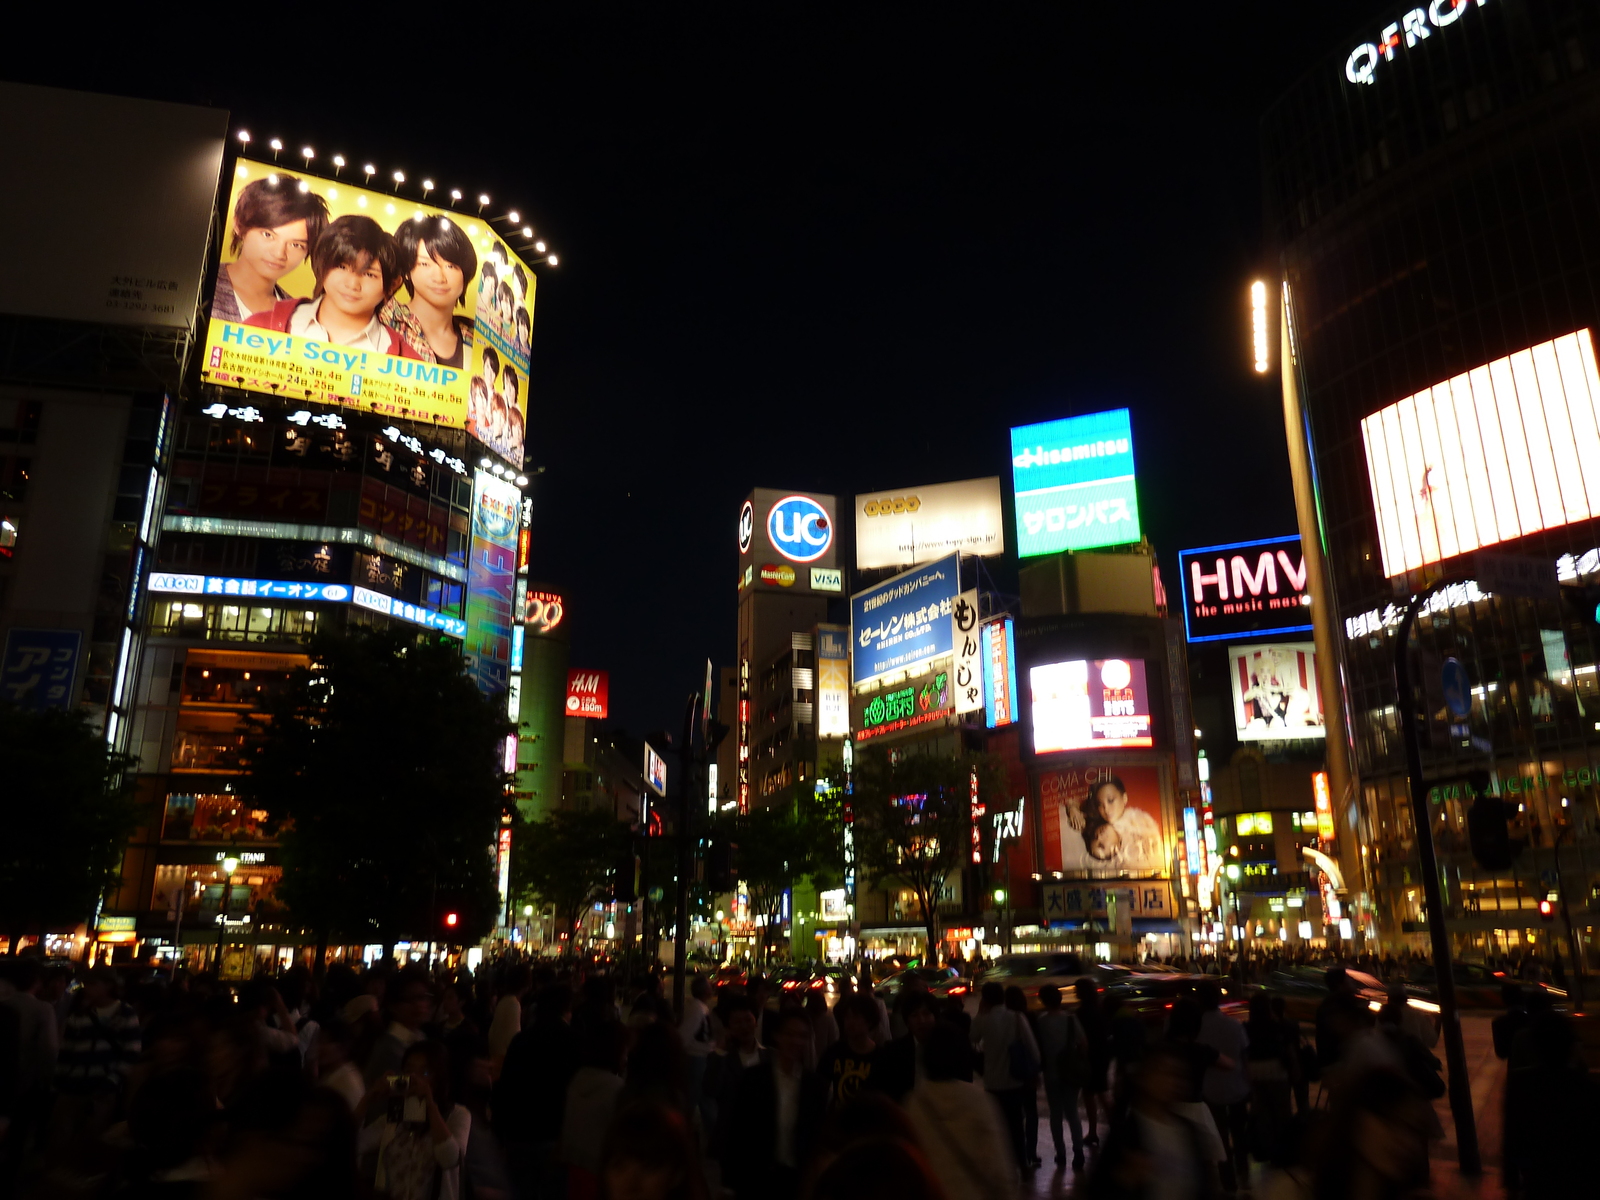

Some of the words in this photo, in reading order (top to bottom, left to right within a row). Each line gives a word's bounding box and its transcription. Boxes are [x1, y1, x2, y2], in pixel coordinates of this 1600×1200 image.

[1345, 0, 1486, 85] QFRO
[222, 324, 293, 355] Hey!
[303, 341, 367, 371] Say!
[377, 357, 458, 386] JUMP
[202, 484, 322, 512] プライス
[360, 497, 444, 545] コンタクト
[1023, 498, 1130, 534] サロンパス
[153, 574, 198, 589] AEON
[207, 577, 319, 597] 英会話イーオン
[760, 569, 796, 581] MasterCard
[814, 574, 840, 585] VISA
[1190, 549, 1307, 604] HMV
[356, 587, 387, 611] AEON
[527, 590, 562, 604] HIBUYA
[1195, 603, 1218, 618] the
[1223, 597, 1263, 615] music
[393, 599, 466, 636] 英会話イーオン
[525, 598, 563, 632] 09
[859, 596, 952, 647] セーレン株式会社
[953, 598, 979, 704] もんじゃ
[47, 648, 73, 711] コンタ
[570, 672, 600, 694] H&M
[993, 796, 1025, 864] クスリ
